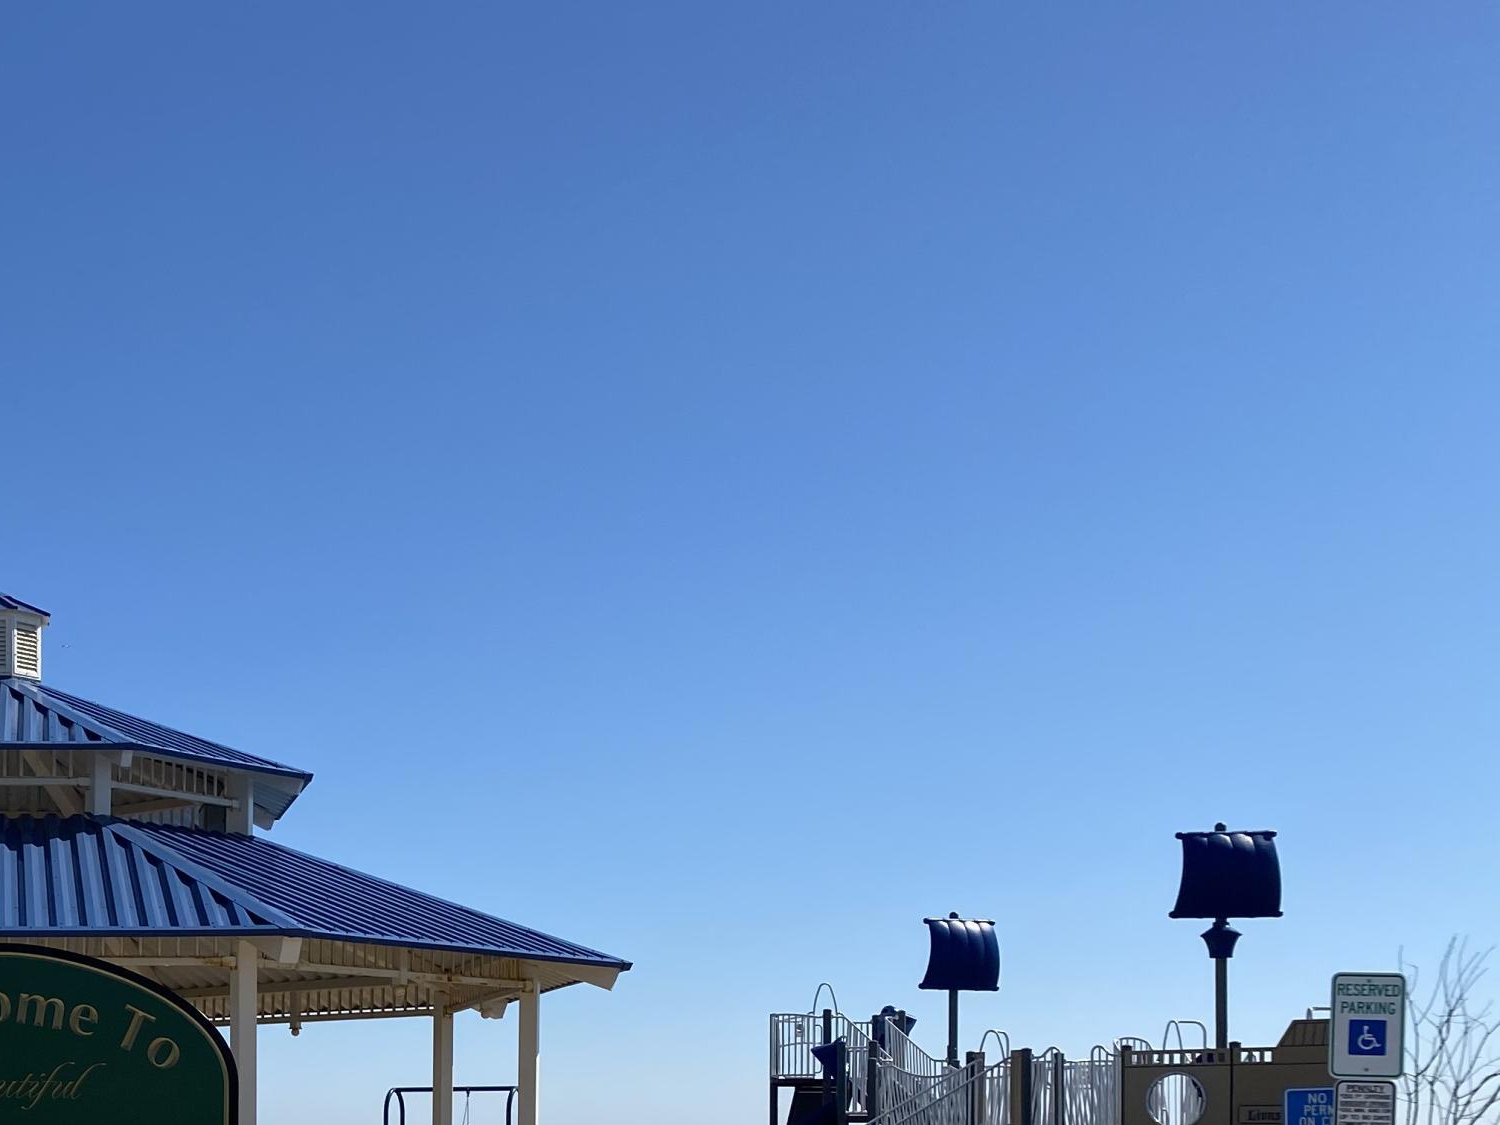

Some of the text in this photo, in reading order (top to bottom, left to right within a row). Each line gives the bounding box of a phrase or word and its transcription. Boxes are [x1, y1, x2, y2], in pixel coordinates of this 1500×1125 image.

[1337, 983, 1400, 997] RESERVED
[1340, 1001, 1396, 1015] PARKING
[119, 1004, 181, 1069] To
[1307, 1093, 1327, 1104] NO
